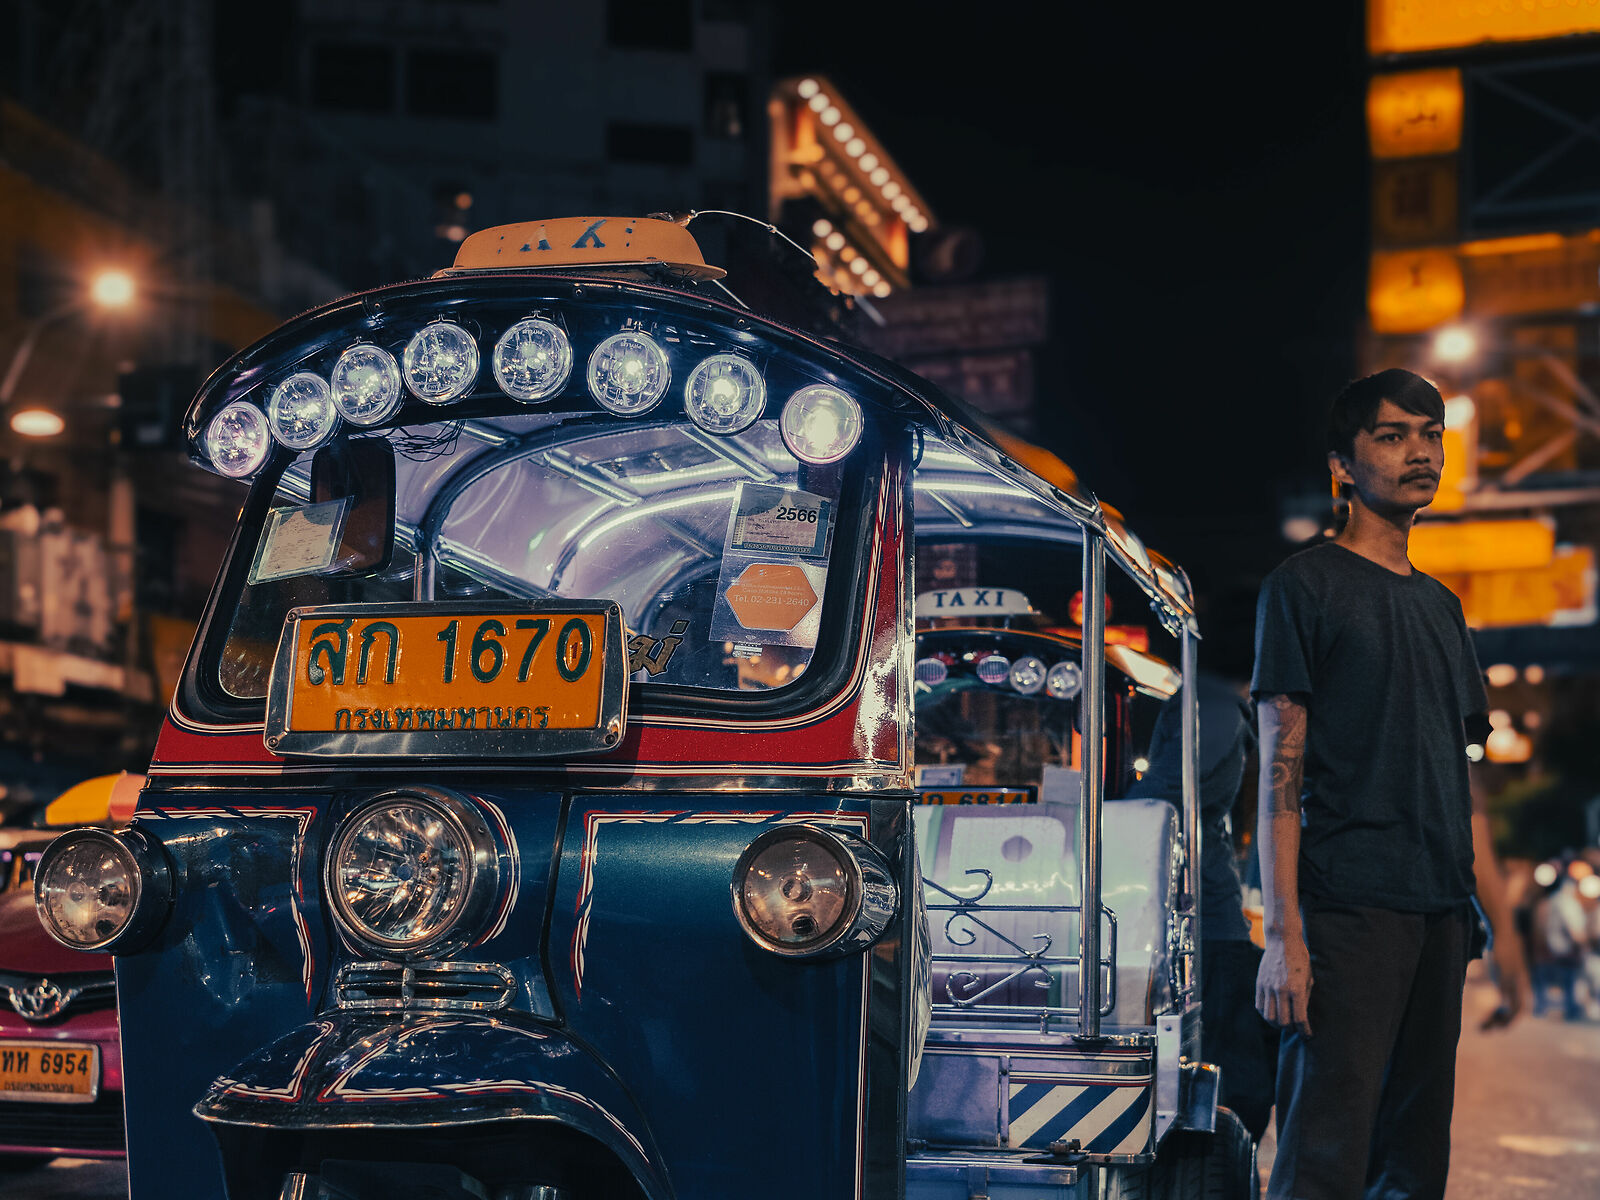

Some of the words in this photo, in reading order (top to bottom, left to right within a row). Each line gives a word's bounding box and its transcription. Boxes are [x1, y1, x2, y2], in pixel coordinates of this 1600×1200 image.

[776, 506, 817, 524] 2566
[933, 590, 1004, 608] TAXI
[307, 617, 401, 686] สก
[437, 617, 594, 684] 1670
[334, 705, 551, 730] กรงเทพมหานคร
[40, 1052, 88, 1076] 6954
